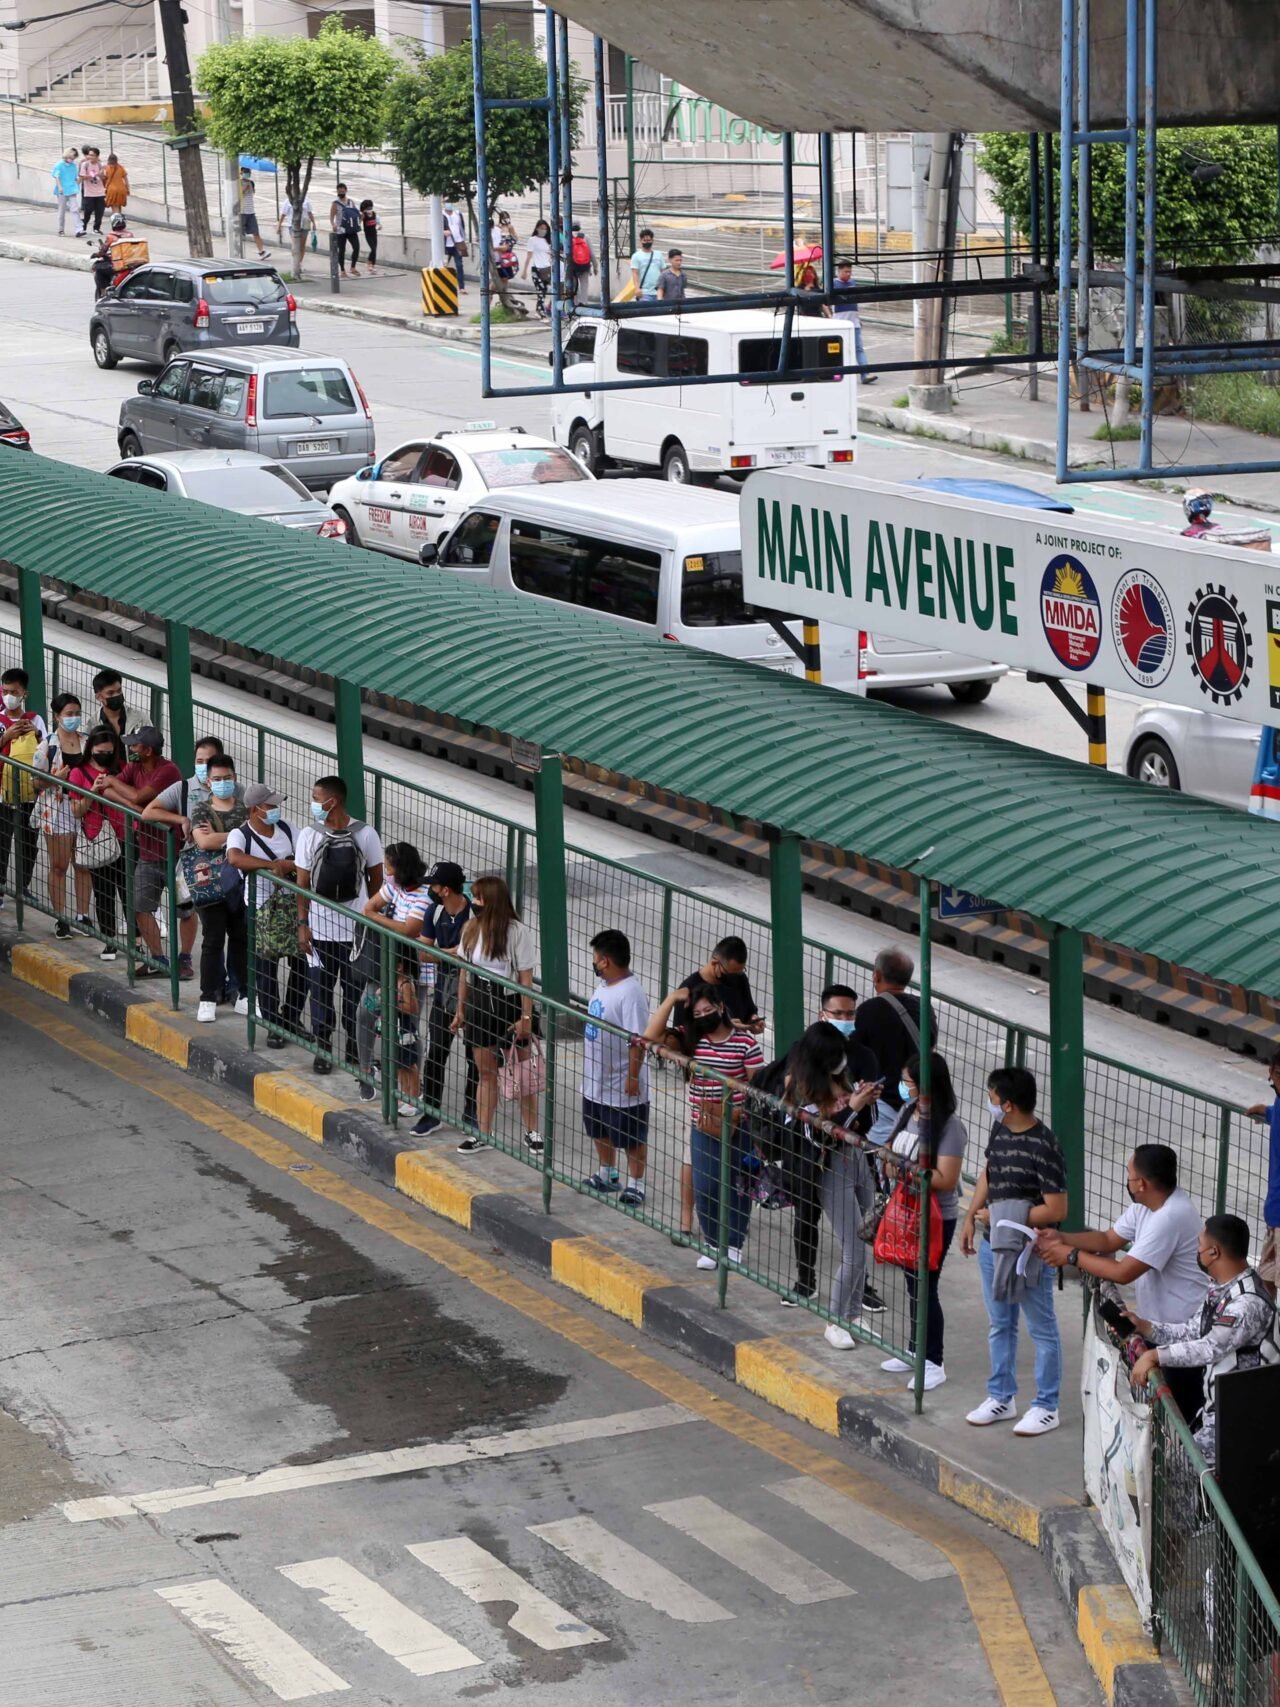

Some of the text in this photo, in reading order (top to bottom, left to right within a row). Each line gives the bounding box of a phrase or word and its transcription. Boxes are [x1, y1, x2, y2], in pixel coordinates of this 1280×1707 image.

[368, 507, 391, 524] FREEDOM
[1036, 532, 1122, 560] A JOINT PROJECT OF:
[756, 497, 1019, 637] MAIN AVENUE
[1264, 584, 1274, 594] IN
[1045, 599, 1098, 634] MMDA
[1114, 574, 1174, 657] Department of Transportation
[1138, 674, 1154, 684] 1899
